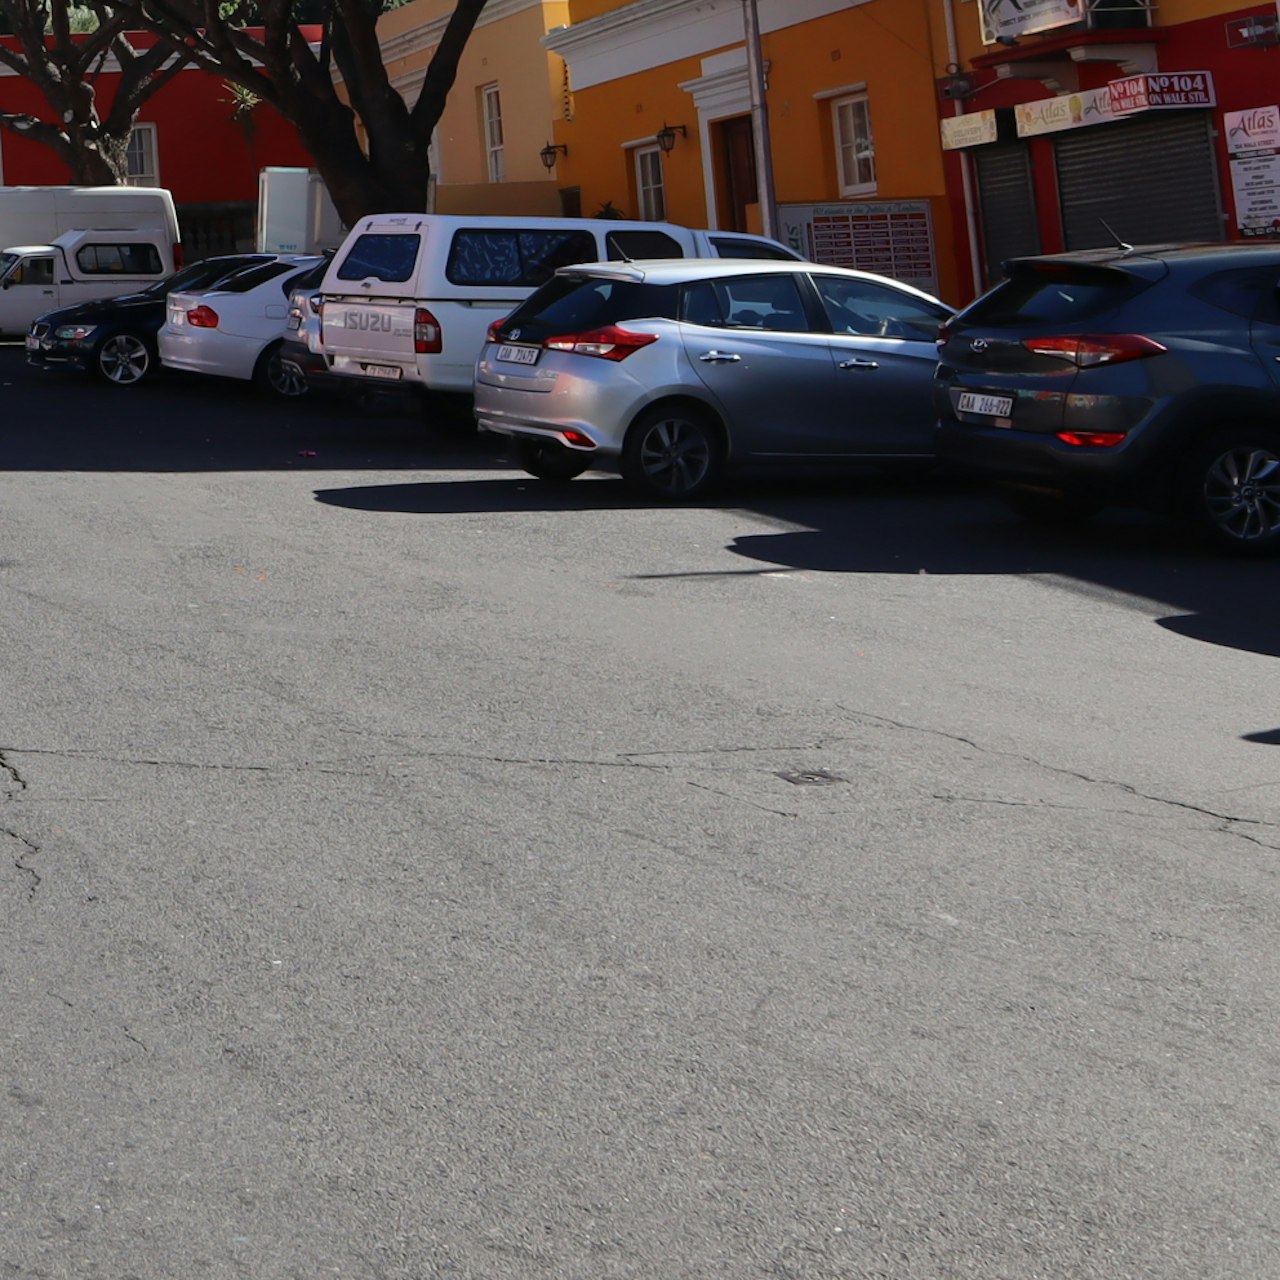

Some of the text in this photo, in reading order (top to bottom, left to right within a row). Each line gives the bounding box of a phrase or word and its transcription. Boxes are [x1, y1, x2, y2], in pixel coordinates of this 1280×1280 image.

[1124, 79, 1144, 95] 104
[1171, 75, 1204, 91] 104
[1149, 93, 1164, 105] ON
[1164, 92, 1187, 104] WALE
[1033, 102, 1067, 125] Atlas
[1230, 111, 1275, 137] Atlas
[344, 311, 392, 332] ISUZU
